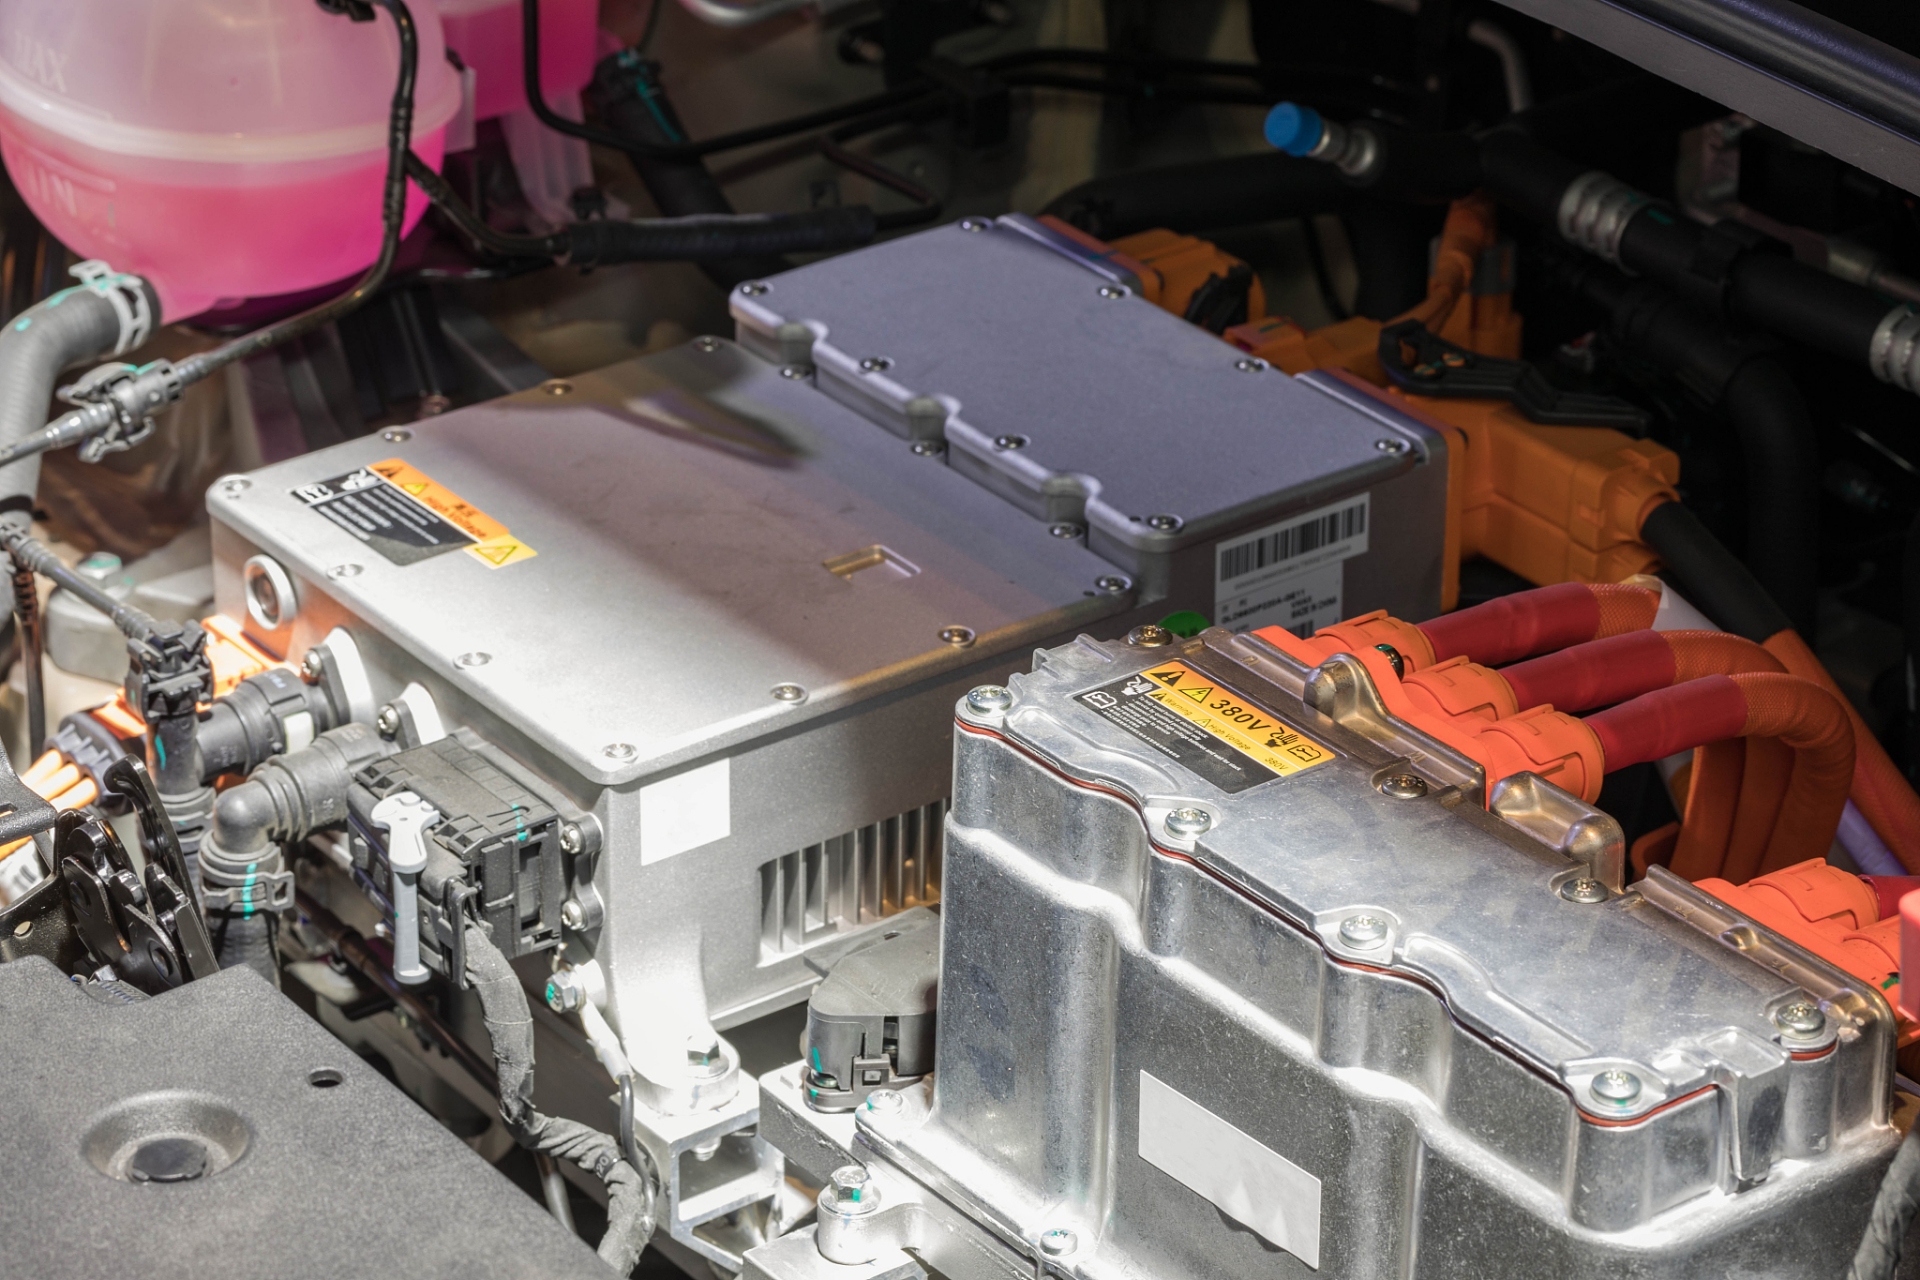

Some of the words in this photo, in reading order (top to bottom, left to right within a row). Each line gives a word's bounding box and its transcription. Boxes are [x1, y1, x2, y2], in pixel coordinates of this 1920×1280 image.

[1165, 698, 1193, 716] Warning
[1208, 724, 1225, 734] High
[1226, 734, 1251, 750] Voltage
[1264, 757, 1288, 770] 380V
[1210, 699, 1271, 730] 380V
